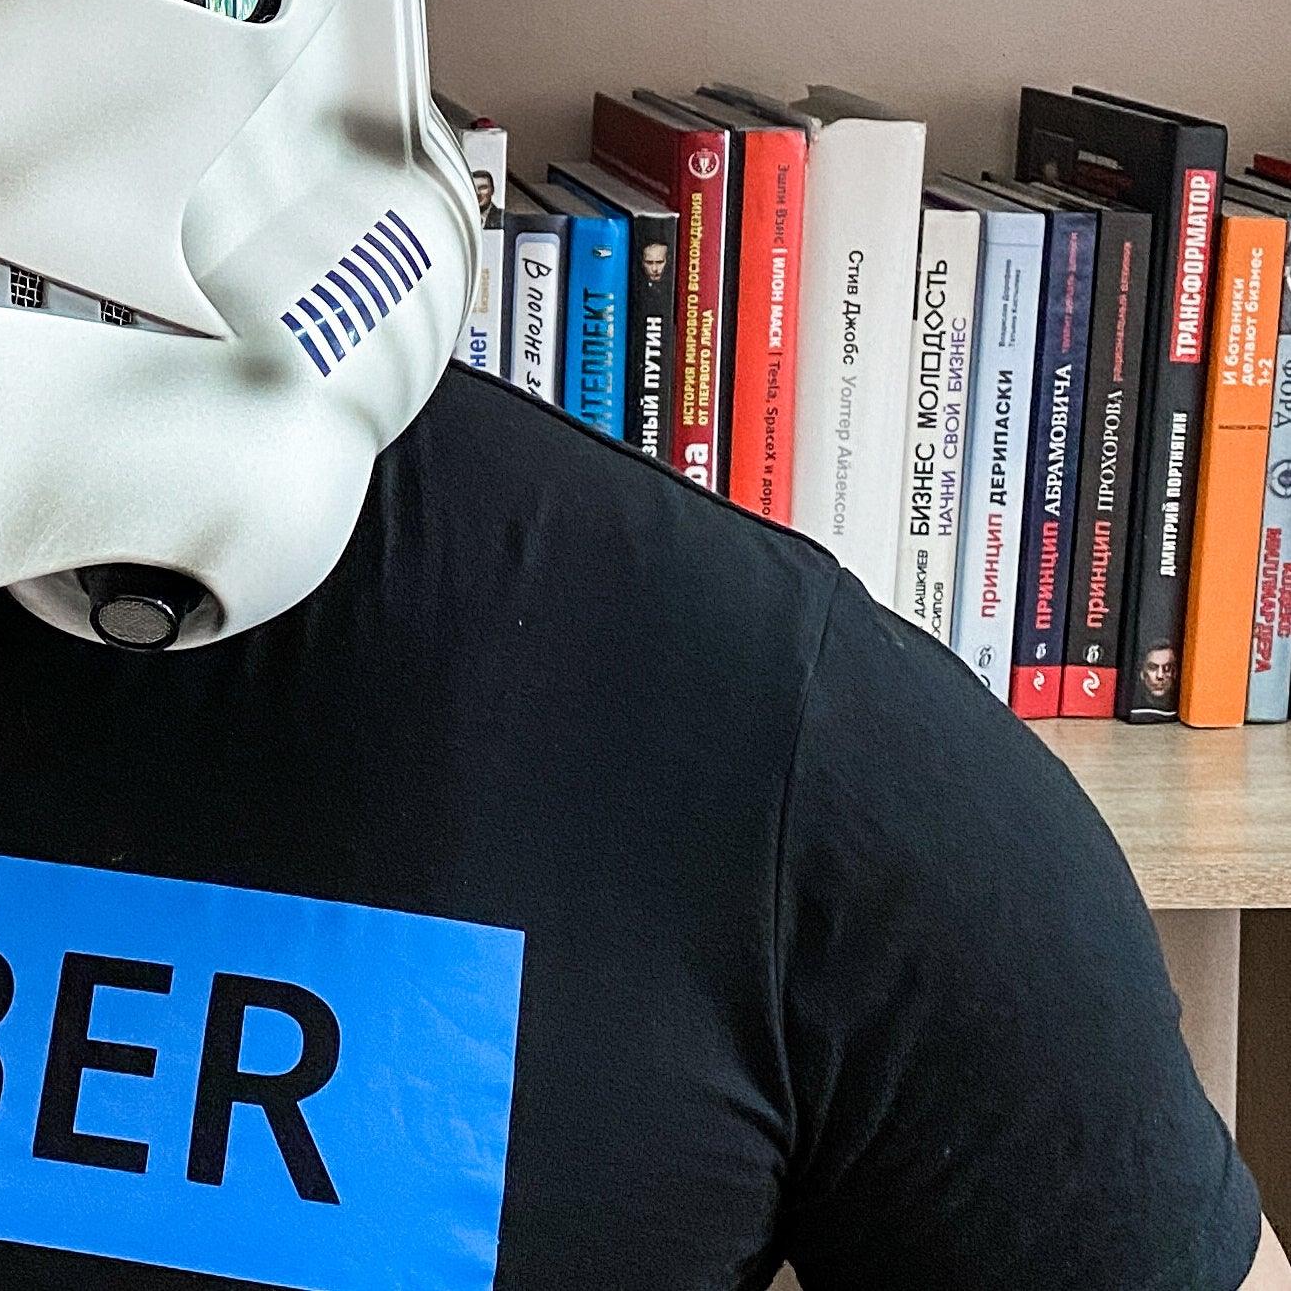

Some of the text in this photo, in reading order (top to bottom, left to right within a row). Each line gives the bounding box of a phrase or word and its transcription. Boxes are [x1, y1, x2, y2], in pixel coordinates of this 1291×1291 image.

[522, 258, 553, 279] В
[682, 192, 703, 426] ИСТОРИЯ МИРОВОГО ВОСХОЖДЕНИЯ
[768, 305, 784, 348] МАСК
[771, 257, 786, 302] ИЛОН
[1175, 175, 1211, 357] ТРАНСФОРМАТОР
[1241, 247, 1264, 387] делают бизнес
[644, 316, 663, 389] ПУТИН
[698, 308, 714, 426] ОТ ПЕРВОГО ЛИЦА
[833, 250, 864, 536] Стив Джобс Уолтер Айзексон
[1222, 277, 1246, 386] И ботаники
[1258, 358, 1274, 388] 1+2
[764, 407, 779, 461] SpaceX
[910, 260, 948, 536] БИЗНЕС МОЛОДОСТЬ
[938, 317, 967, 537] НАЧНИ СВОЙ БИЗНЕС
[989, 370, 1014, 507] ДЕРИПАСКИ
[1044, 363, 1072, 517] АБРАМОВИЧА
[1087, 390, 1123, 628] принцип ПРОХОРОВА
[1160, 412, 1188, 577] ДМИТРИЙ ПОРТНЯГИН
[914, 549, 929, 619] ДАШКИЕВ
[981, 514, 1004, 618] принцип
